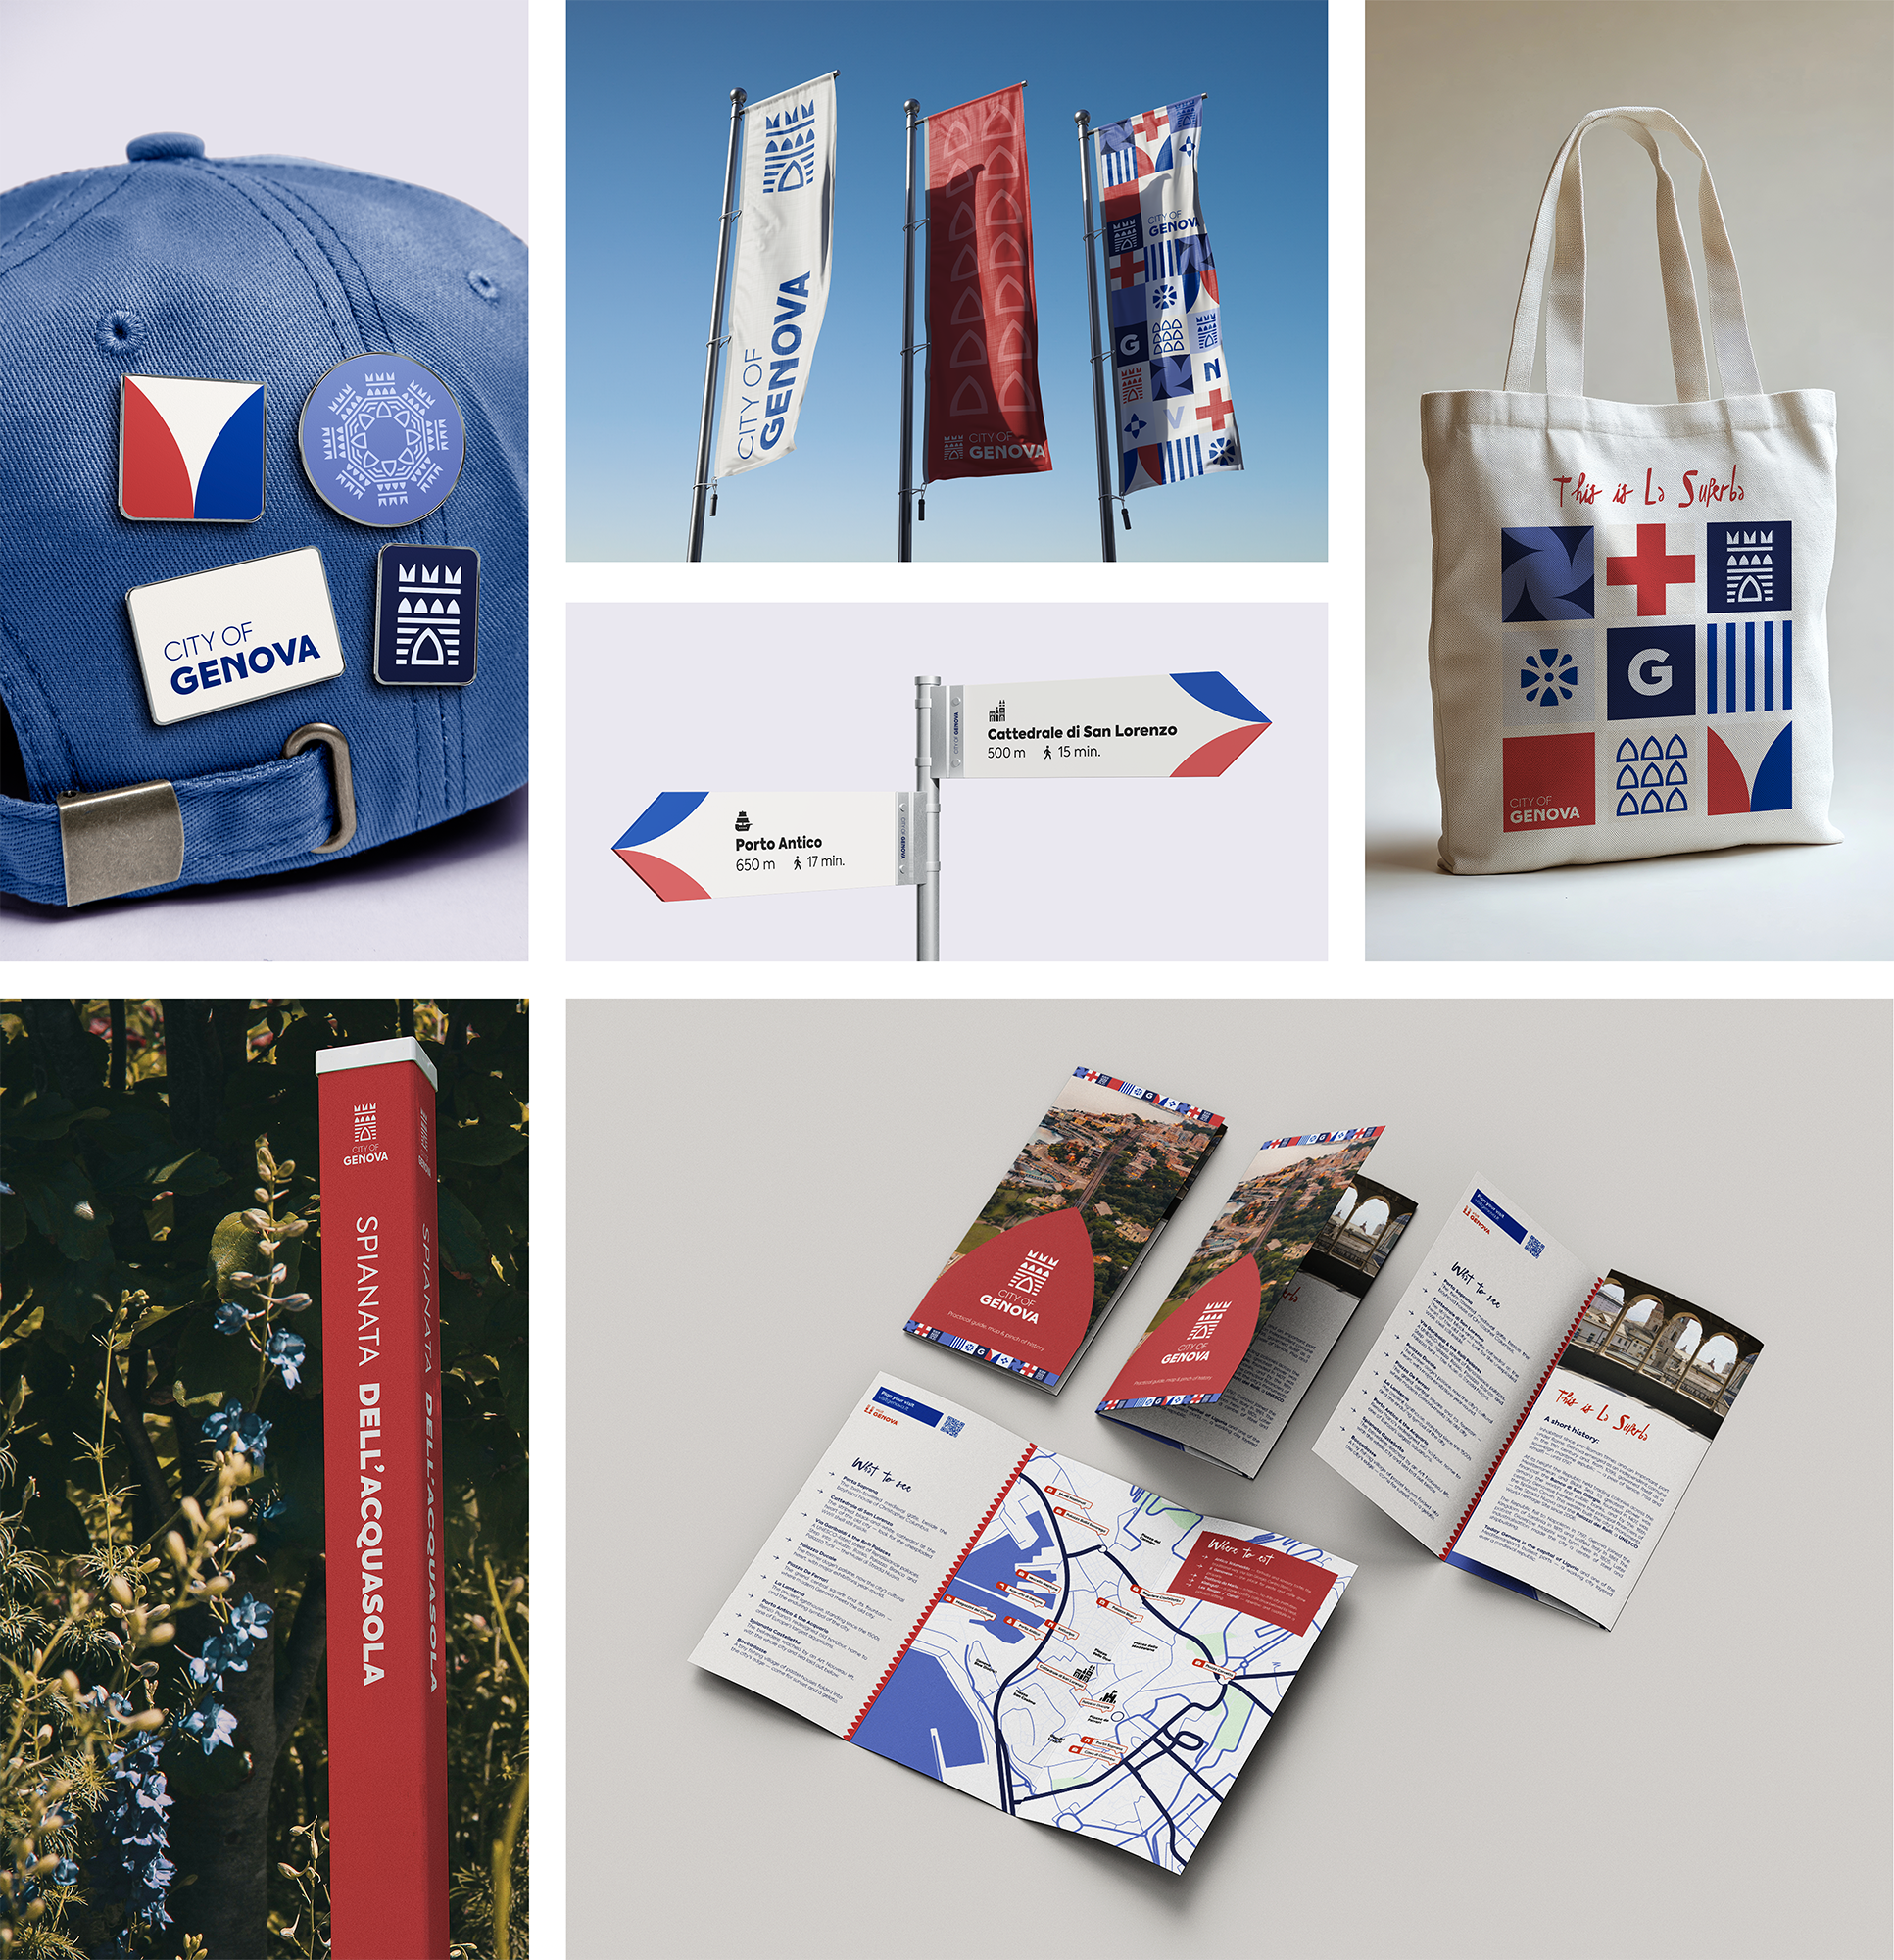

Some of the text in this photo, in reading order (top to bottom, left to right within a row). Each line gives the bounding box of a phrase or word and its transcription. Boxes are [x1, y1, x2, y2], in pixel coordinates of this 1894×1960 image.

[1147, 210, 1182, 225] CITY OF
[1120, 333, 1140, 356] G
[759, 270, 811, 451] GENOVA
[1203, 357, 1221, 382] N
[738, 349, 762, 460] CITY OF
[1163, 406, 1185, 429] V
[969, 431, 1012, 443] CITY OF
[969, 444, 1045, 460] GENOVA
[1552, 464, 1745, 508] This is La Superba
[164, 621, 253, 662] CITY OF
[170, 633, 321, 695] GENOVA
[1627, 648, 1674, 696] G
[987, 724, 1178, 740] Cattedrale di San Lorenzo
[987, 746, 1101, 759] 500 m 15 min.
[1510, 795, 1552, 808] CITY OF
[1510, 806, 1580, 823] GENOVA
[736, 835, 822, 851] Porto Antico
[736, 855, 845, 871] 650 m 17 min.
[352, 1143, 379, 1153] CITY OF
[343, 1152, 388, 1166] GENOVA
[1470, 1215, 1490, 1235] GENOVA
[422, 1223, 432, 1373] SPIANATA
[998, 1289, 1036, 1307] CITY OF
[1476, 1282, 1486, 1294] to
[1486, 1295, 1500, 1308] see
[980, 1294, 1040, 1325] GENOVA
[947, 1311, 972, 1323] Practical
[988, 1325, 1000, 1336] map
[1005, 1332, 1020, 1343] pinch
[1027, 1341, 1044, 1352] history
[1161, 1350, 1210, 1364] GENOVA
[1177, 1342, 1209, 1352] CITY OF
[871, 1409, 898, 1425] GENOVA
[1556, 1389, 1578, 1406] This
[1580, 1403, 1594, 1413] is
[1612, 1414, 1650, 1441] Superba
[1551, 1419, 1571, 1431] short
[1572, 1427, 1599, 1444] history:
[356, 1216, 385, 1687] SPIANATA DELL'ACQUASOLA
[882, 1471, 895, 1482] to
[896, 1481, 911, 1492] see
[1208, 1539, 1238, 1554] Where
[1242, 1547, 1255, 1558] to
[1618, 1535, 1639, 1548] UNESCO
